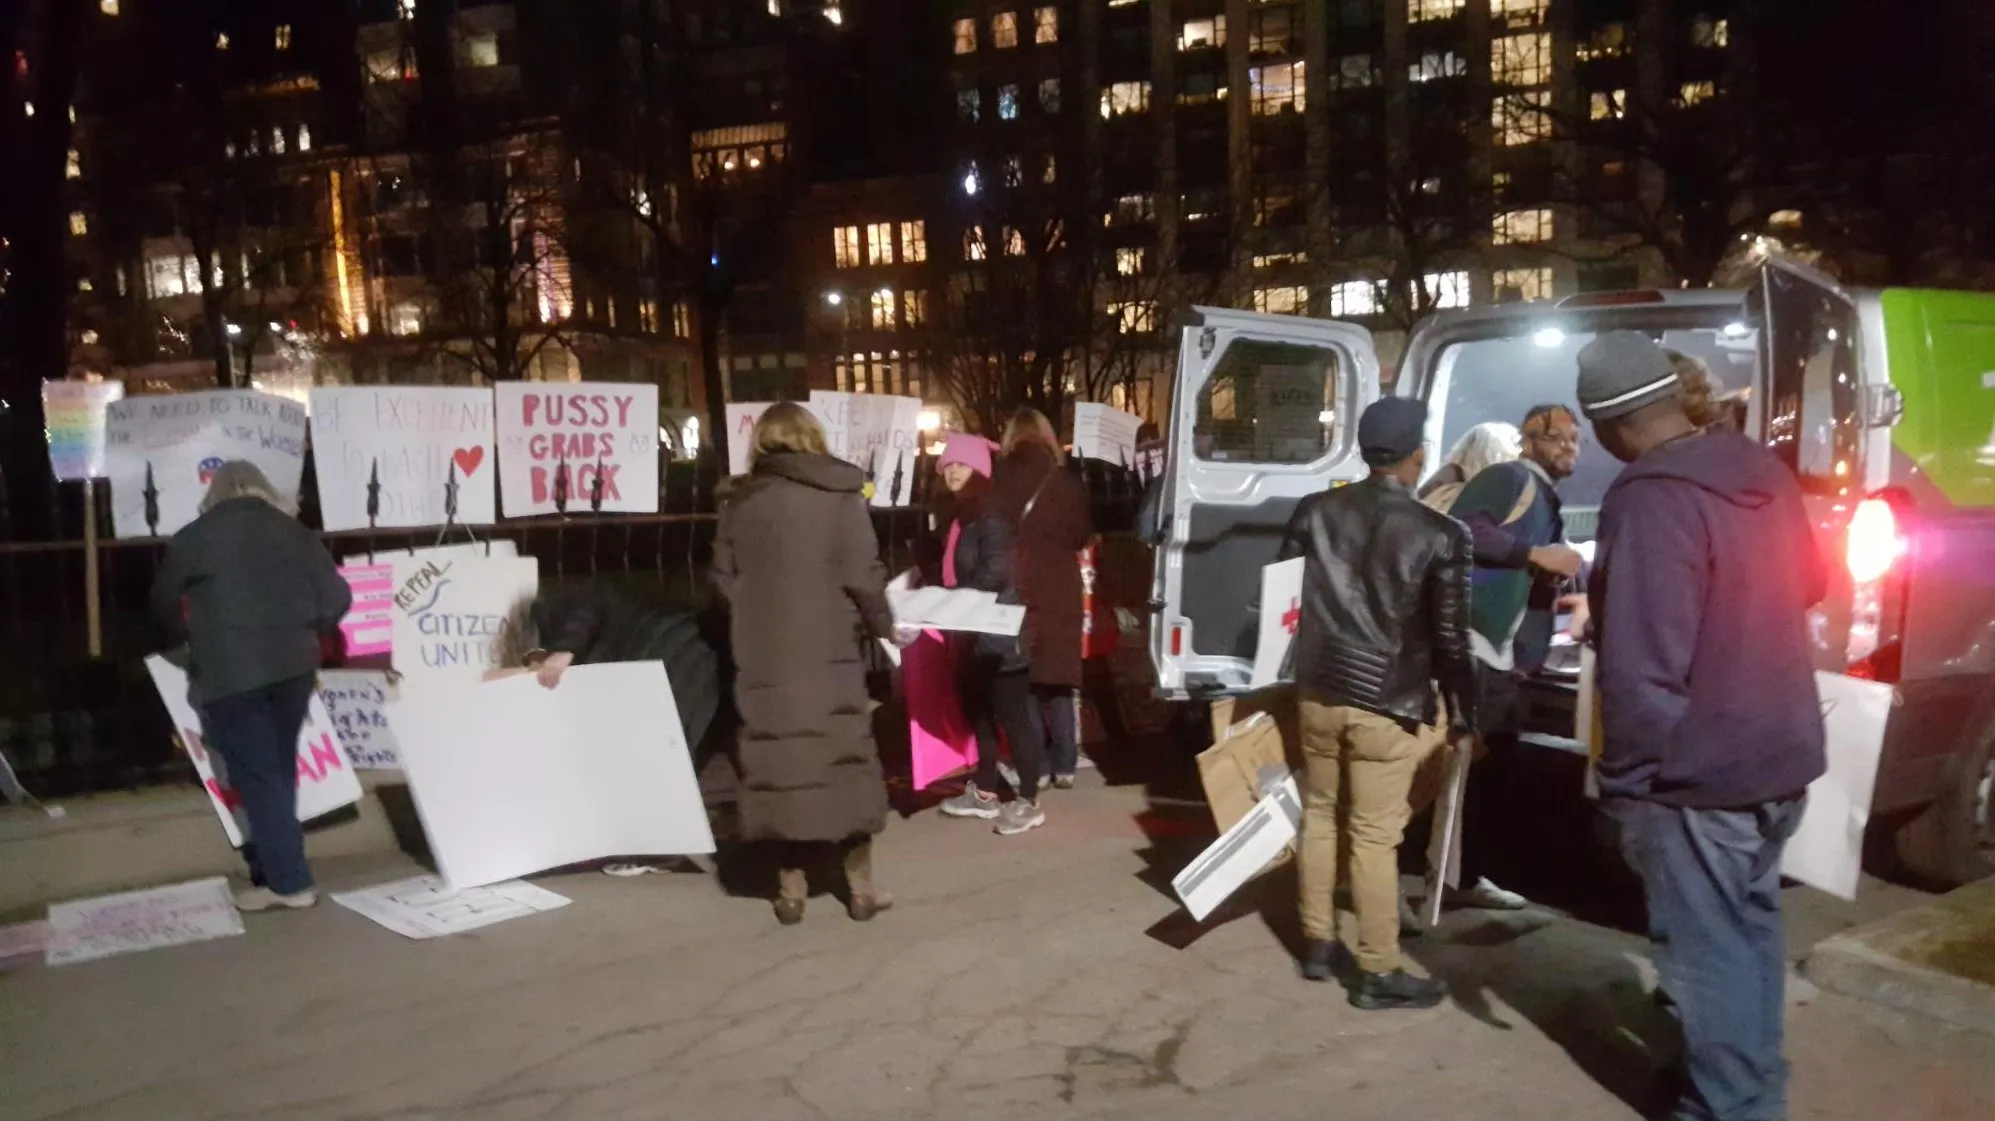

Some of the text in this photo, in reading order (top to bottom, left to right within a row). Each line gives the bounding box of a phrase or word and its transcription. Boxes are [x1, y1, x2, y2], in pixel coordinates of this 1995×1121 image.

[209, 397, 229, 414] TO
[236, 396, 272, 419] TALK
[522, 394, 634, 427] PUSSY
[528, 432, 615, 460] GRABS
[530, 464, 621, 504] BACK
[393, 560, 453, 611] REPEAL
